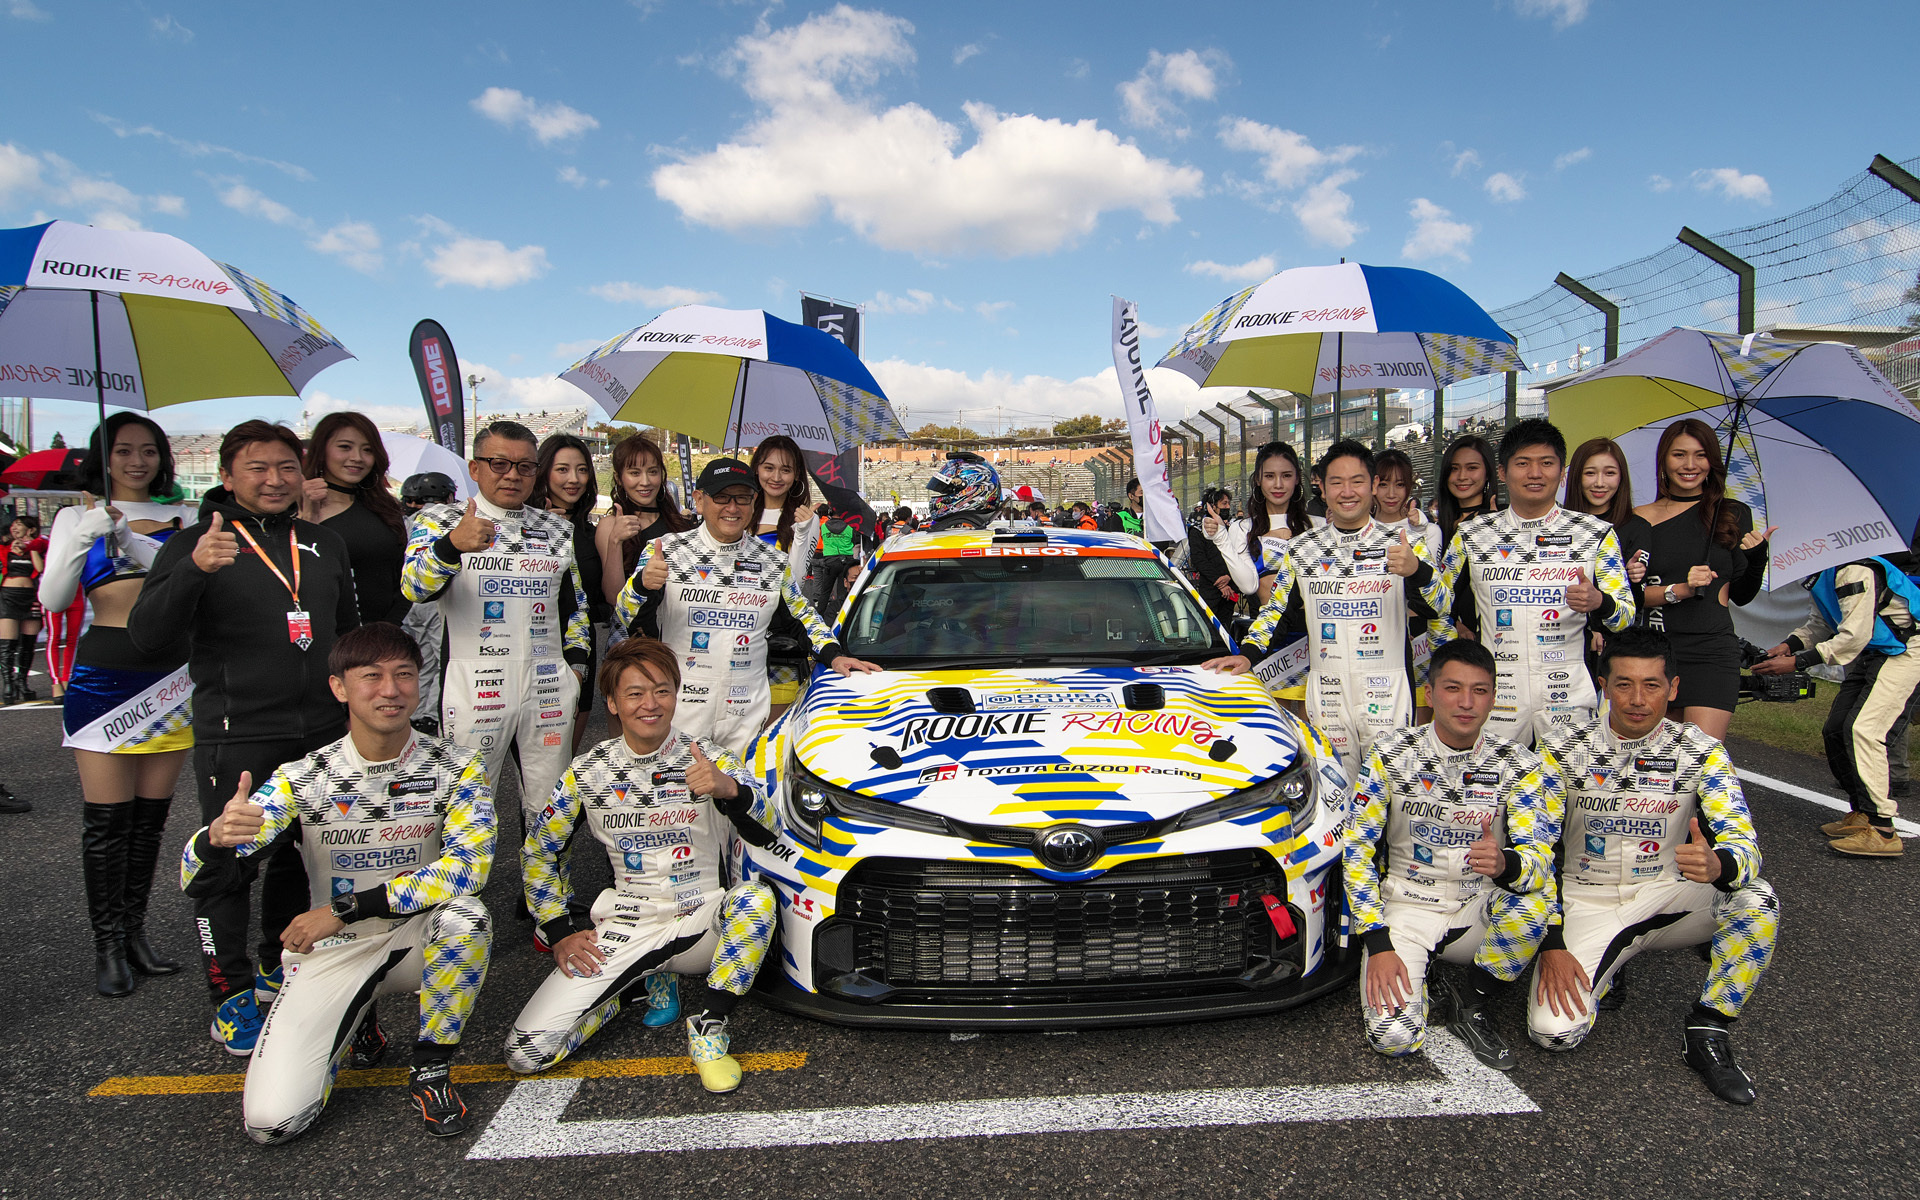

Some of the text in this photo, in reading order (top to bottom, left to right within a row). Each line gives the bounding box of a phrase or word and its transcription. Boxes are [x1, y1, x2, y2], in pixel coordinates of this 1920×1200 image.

[42, 259, 233, 294] ROOKIE RACING
[1235, 305, 1368, 329] ROOKIE RACING
[637, 332, 762, 349] ROOKIE RACING
[714, 466, 730, 475] ROOKIE
[1522, 520, 1544, 528] ROOKIE
[1264, 538, 1287, 550] ROOKIE
[1341, 534, 1360, 544] ROOKIE
[720, 543, 740, 552] ROOKIE
[985, 547, 1078, 557] ENEOS
[468, 556, 560, 574] ROOKIE RACING
[1482, 567, 1578, 582] ROOKIE RACING
[501, 579, 548, 588] OGURA
[1309, 580, 1392, 594] ROOKIE RACING
[501, 587, 548, 596] CLUTCH
[680, 588, 768, 608] ROOKIE RACING
[912, 599, 954, 608] RECARO
[708, 610, 754, 620] OGURA
[708, 618, 754, 628] CLUTCH
[474, 679, 504, 688] JTEKT
[538, 676, 558, 684] AISIN
[102, 673, 192, 742] ROOKIE RACI
[900, 711, 1222, 752] ROOKIE RACING
[1621, 739, 1648, 750] ROOKIE
[634, 756, 659, 765] ROOKIE
[1448, 754, 1472, 764] ROOKIE
[368, 762, 398, 775] ROOKIE
[918, 764, 1202, 784] GR TOYOTA GAZOO Racing
[400, 779, 435, 790] HANKOOK
[1401, 800, 1449, 821] ROOKIE
[1576, 796, 1680, 814] ROOKIE RACING
[602, 809, 699, 829] ROOKIE RACING
[1606, 818, 1662, 828] OGURA
[321, 822, 436, 846] ROOKIE RACING
[634, 832, 688, 842] OGURA
[1604, 826, 1662, 836] CLUTCH
[634, 838, 689, 850] CLUTCH
[1430, 835, 1474, 846] CLUTC
[354, 847, 416, 860] OGURA
[354, 856, 416, 868] CLUTCH
[792, 907, 812, 922] Kawasaki
[196, 917, 216, 956] ROOKIE
